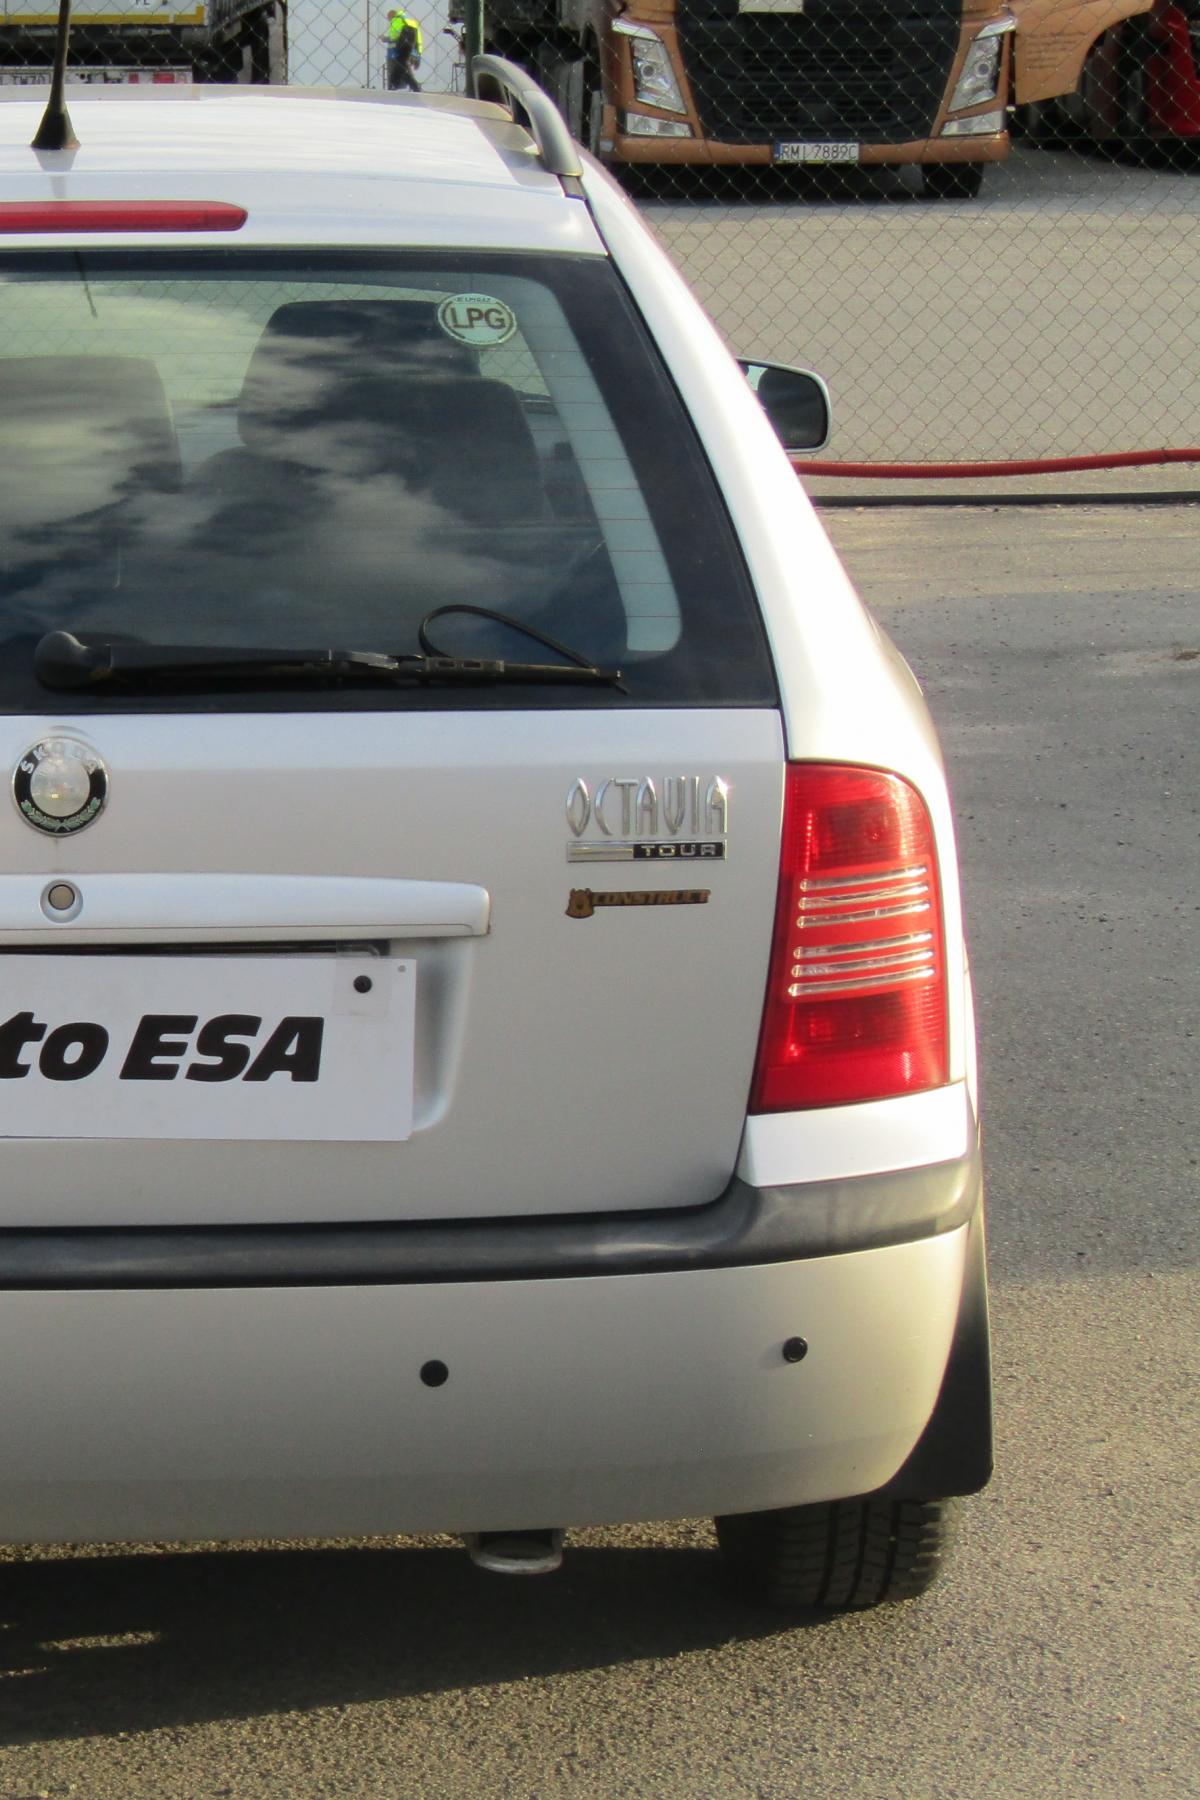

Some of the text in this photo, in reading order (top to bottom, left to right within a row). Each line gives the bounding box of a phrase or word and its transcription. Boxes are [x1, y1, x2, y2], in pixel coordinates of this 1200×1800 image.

[451, 307, 506, 329] LPG
[19, 742, 98, 775] SKA
[565, 775, 729, 837] OCTAVIA
[640, 844, 716, 857] TOUR
[119, 1013, 325, 1082] ESA
